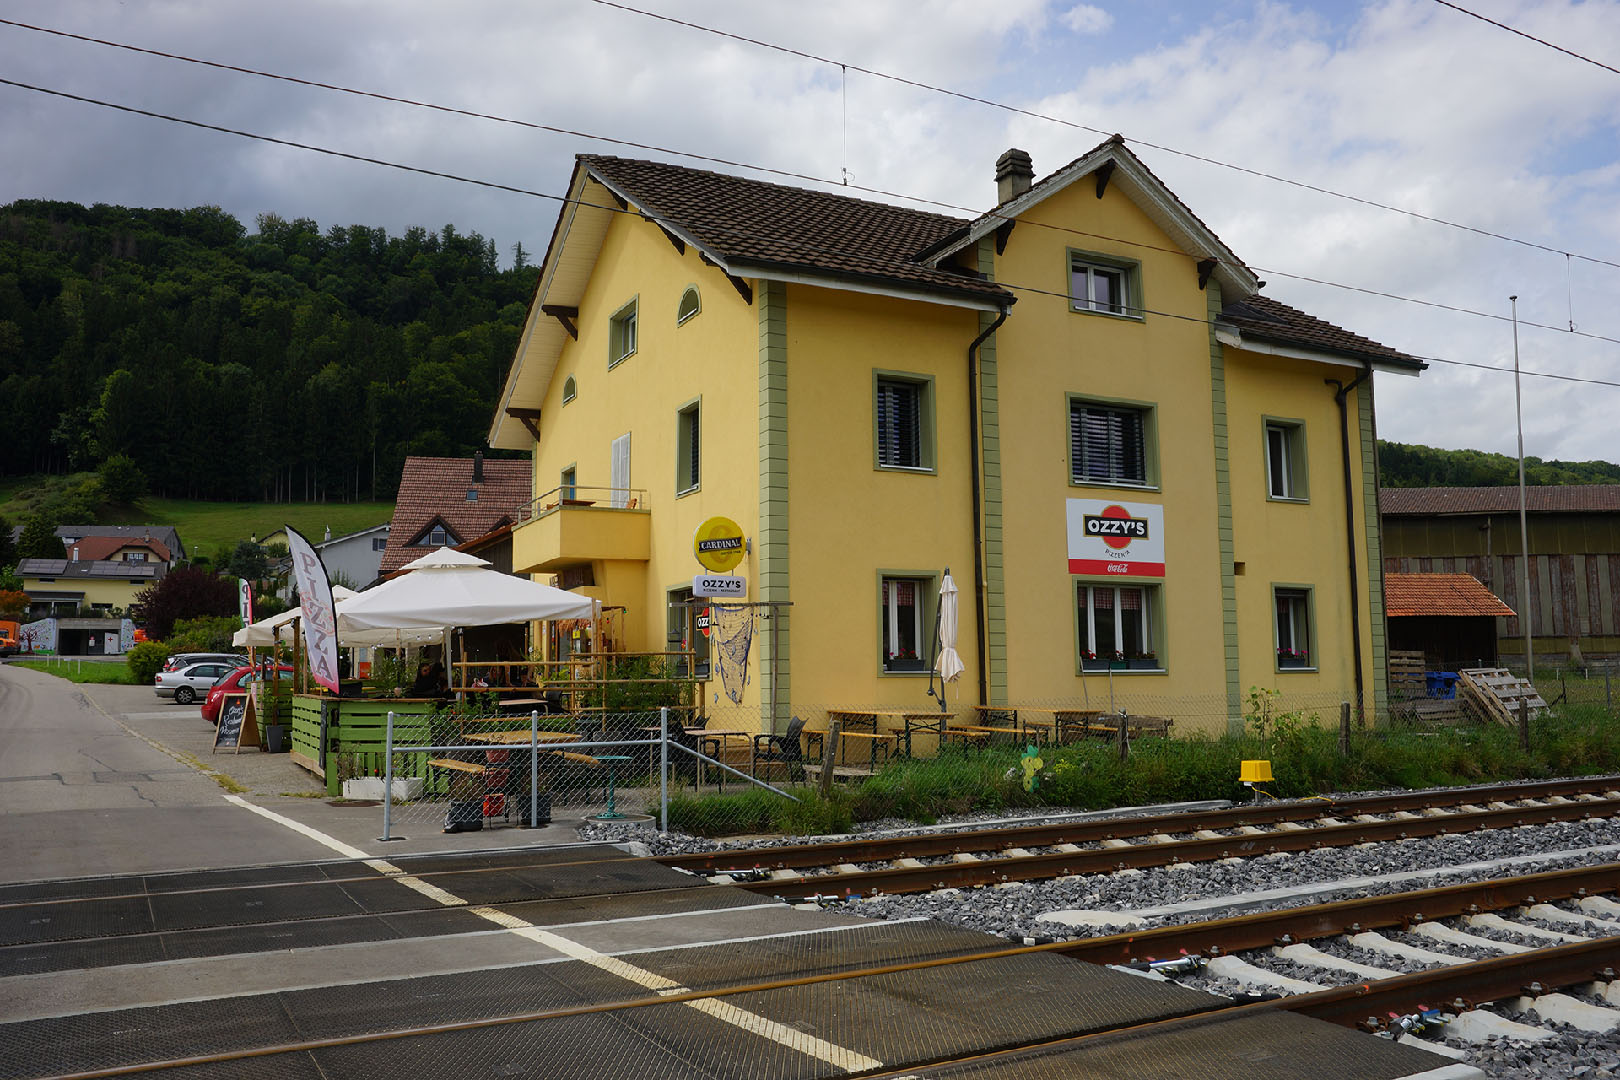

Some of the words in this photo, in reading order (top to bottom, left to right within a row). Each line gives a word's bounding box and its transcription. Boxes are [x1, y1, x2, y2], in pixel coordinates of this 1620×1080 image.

[1087, 519, 1145, 535] OZZY'S
[701, 538, 741, 550] CARDINAL
[702, 579, 742, 589] OZZY'S
[300, 552, 335, 682] PIZZA
